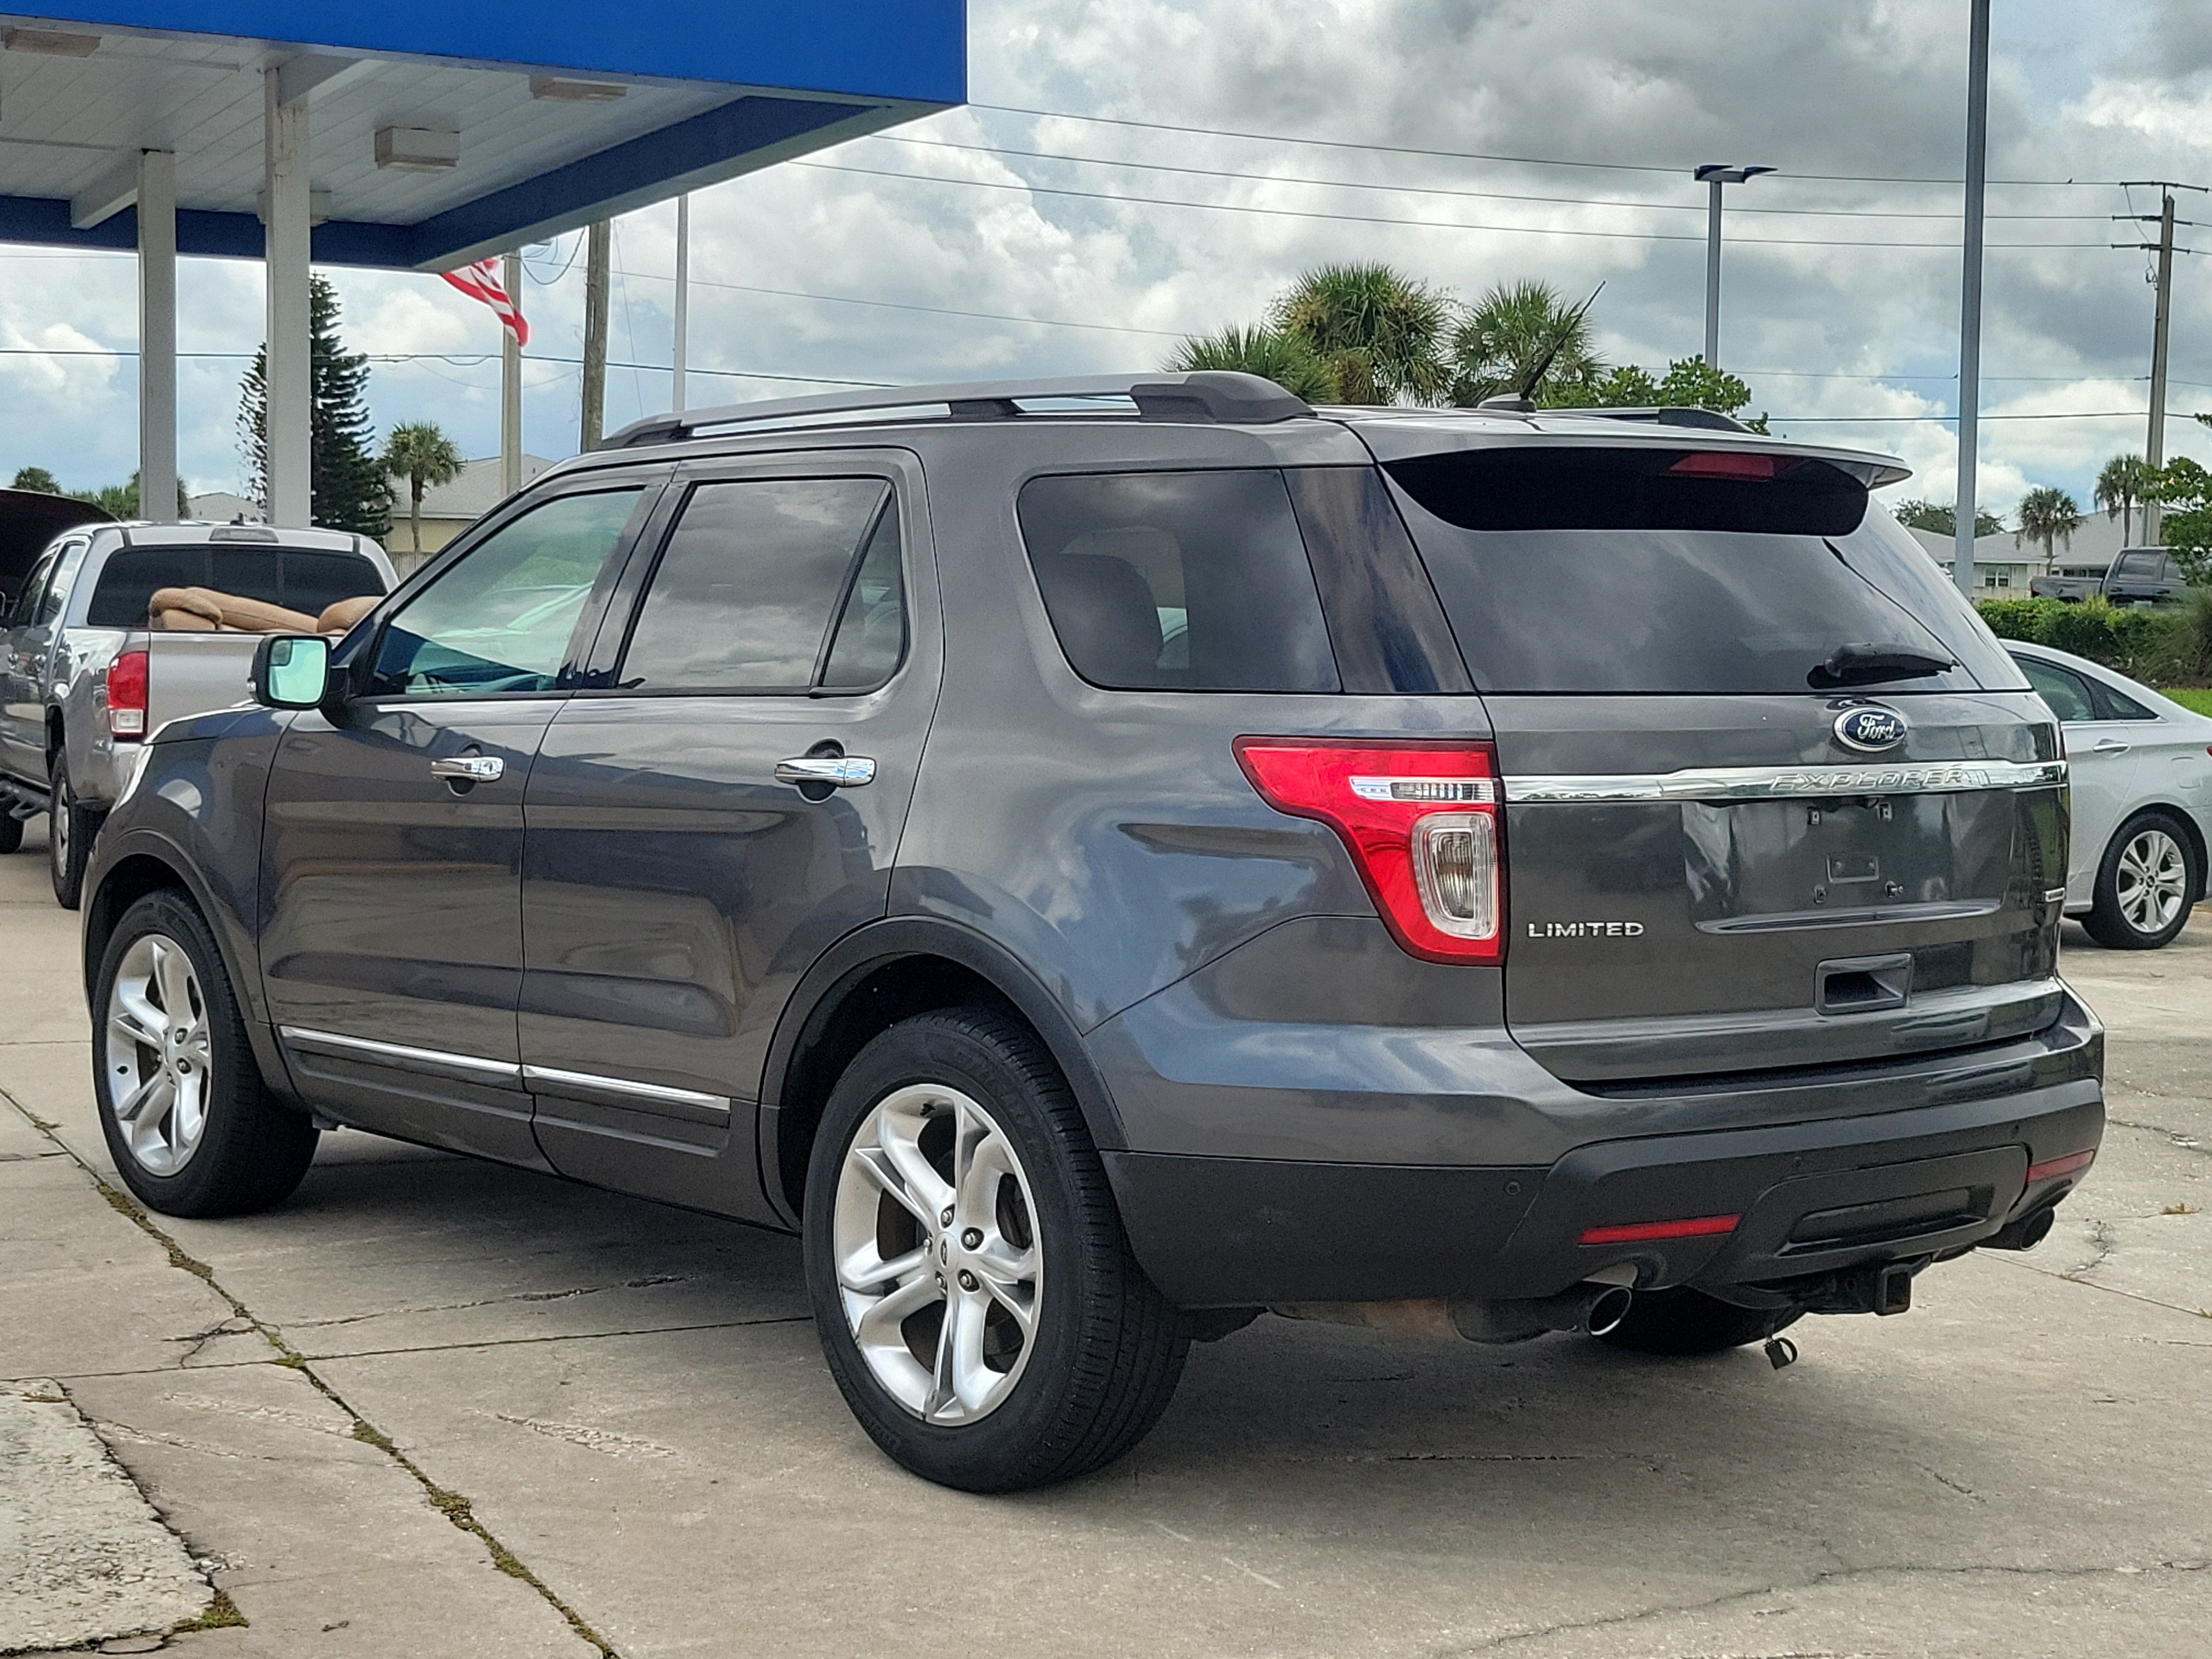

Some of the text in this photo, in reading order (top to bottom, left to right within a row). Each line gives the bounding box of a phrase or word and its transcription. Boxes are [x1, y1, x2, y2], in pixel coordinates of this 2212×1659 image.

[1857, 713, 1896, 740] Ford
[1769, 767, 1964, 791] EXPLORER
[1527, 922, 1645, 938] LIMITED
